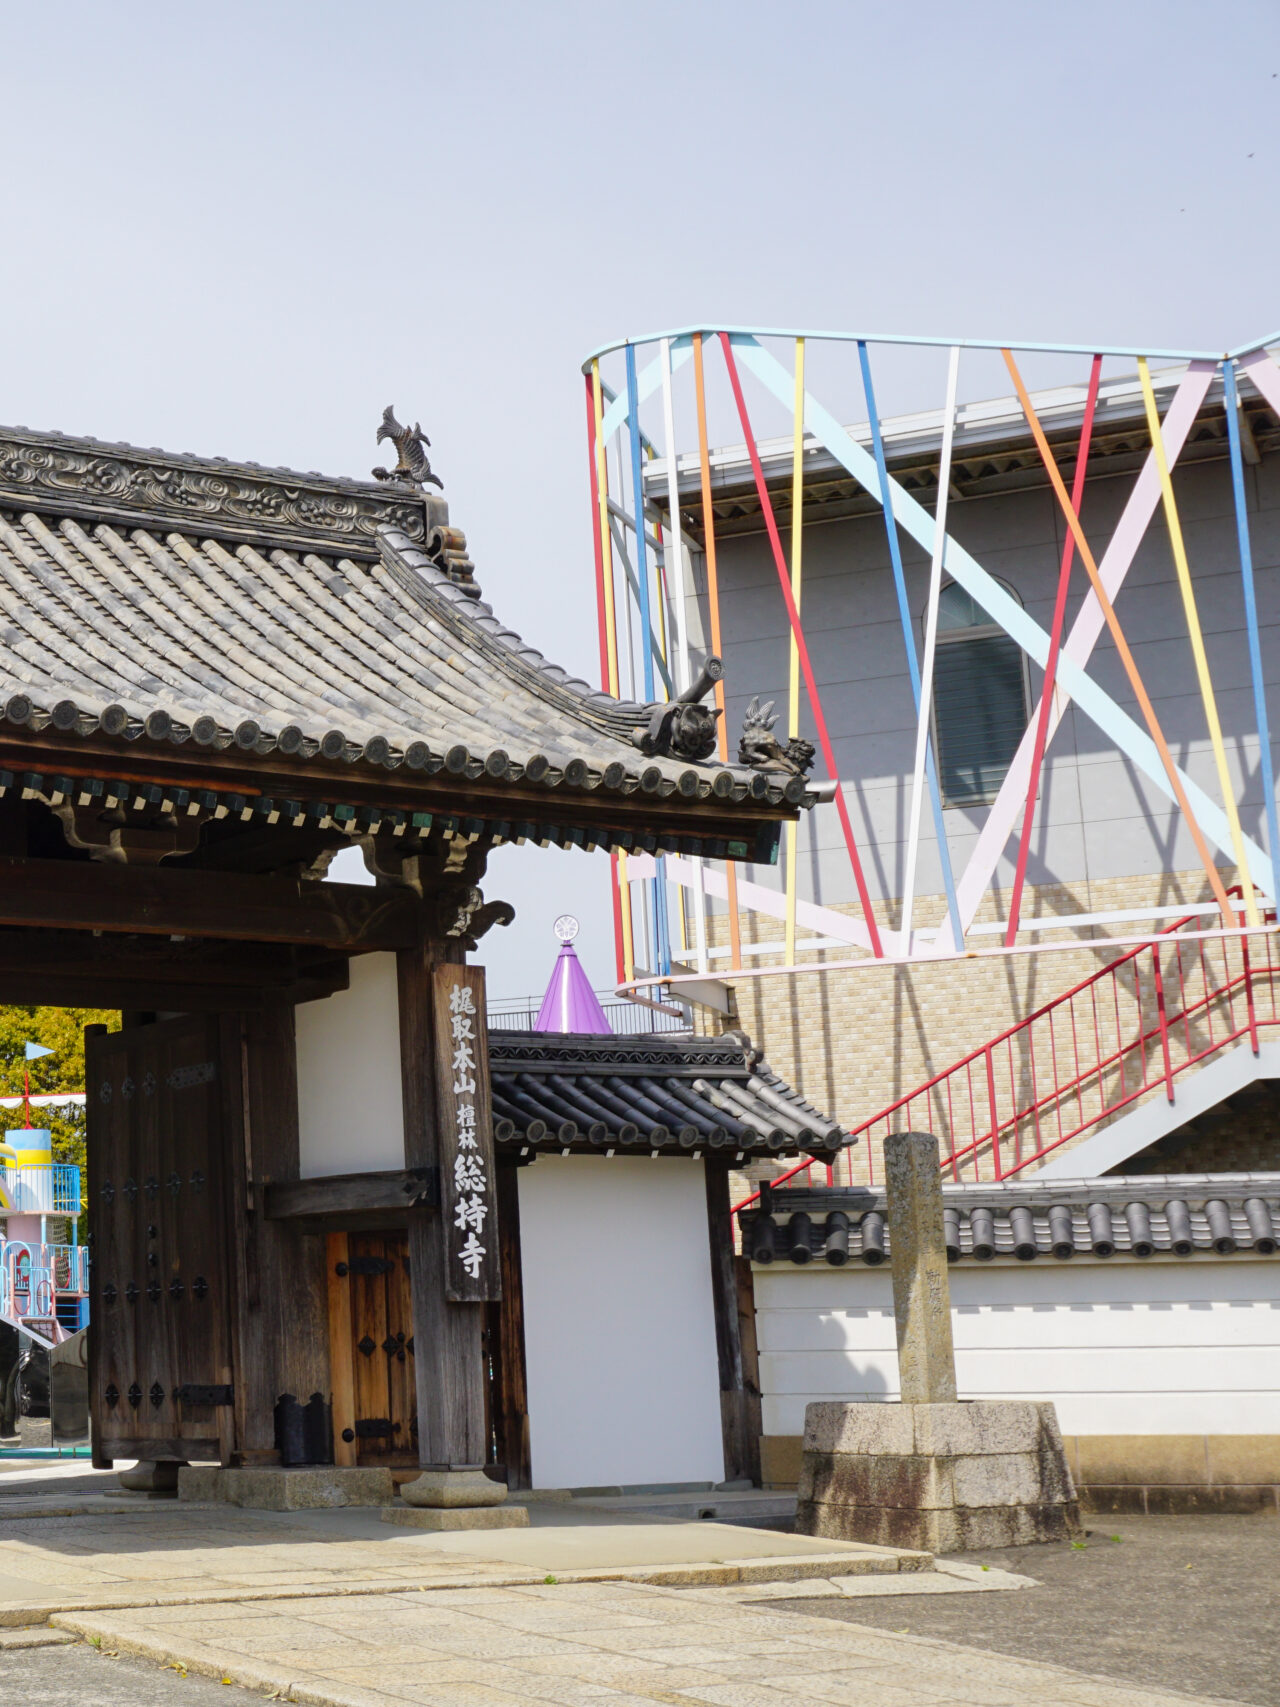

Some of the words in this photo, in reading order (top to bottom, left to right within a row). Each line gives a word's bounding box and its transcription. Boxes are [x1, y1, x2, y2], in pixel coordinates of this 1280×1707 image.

[449, 984, 477, 1095] 梶取本山
[456, 1103, 478, 1150] 檀林
[453, 1154, 488, 1279] 総持寺
